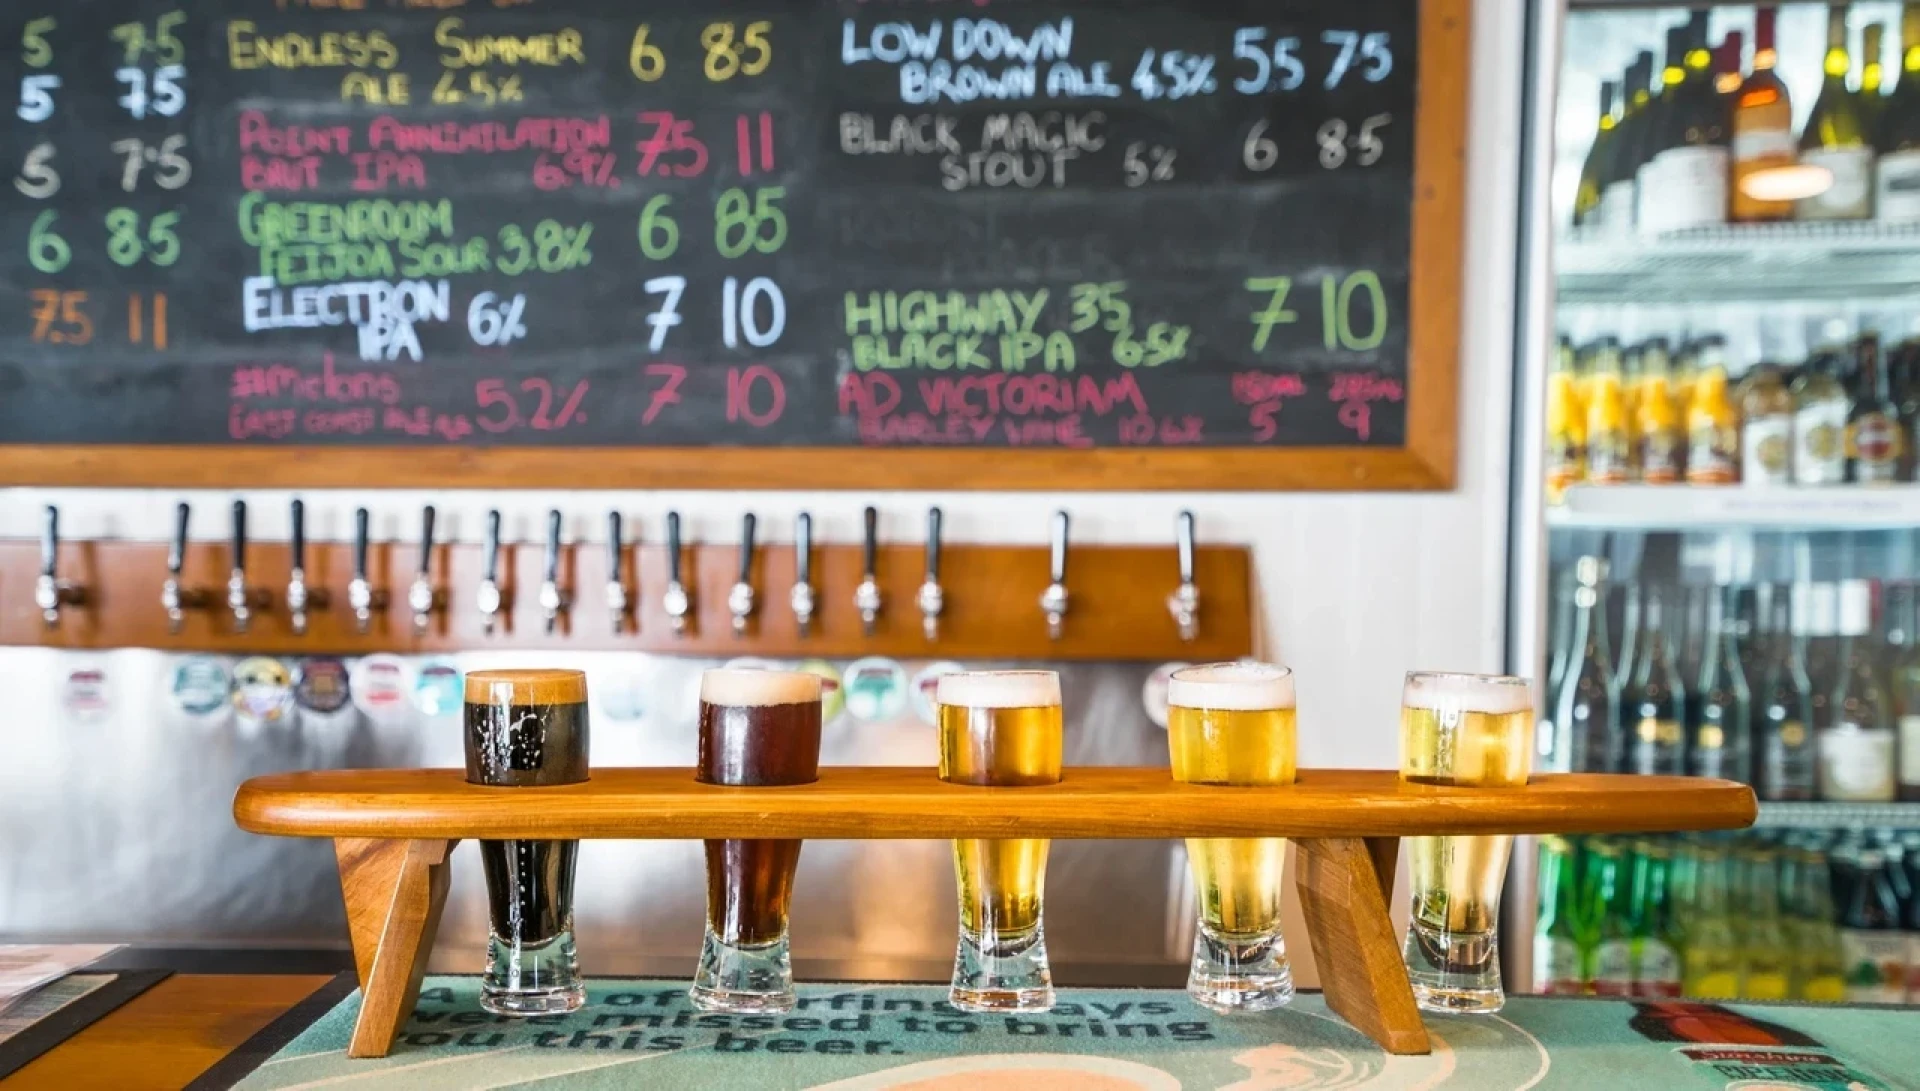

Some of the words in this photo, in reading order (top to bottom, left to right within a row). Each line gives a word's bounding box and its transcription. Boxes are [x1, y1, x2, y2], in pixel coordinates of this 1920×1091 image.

[21, 16, 58, 68] 5
[228, 20, 399, 69] ENDLESS
[434, 17, 585, 68] SUMMER
[630, 23, 666, 82] 6
[701, 20, 772, 82] 8.5
[842, 19, 942, 64] LOW
[953, 16, 1073, 61] DOWN
[16, 74, 62, 122] 5
[341, 72, 409, 105] ALE
[901, 58, 1036, 103] BROWN
[1046, 61, 1122, 99] ALE
[240, 110, 349, 157] POINT
[636, 111, 708, 178] 7.5
[736, 110, 774, 177] 11
[839, 112, 960, 155] BLACK
[981, 111, 1107, 153] MAGIC
[940, 148, 1080, 191] STOUT
[1123, 142, 1177, 188] 5%
[1242, 118, 1278, 171] 6
[13, 142, 61, 199] 5
[241, 156, 322, 190] BRUT
[350, 152, 426, 191] IPA
[533, 151, 621, 191] 6.9%
[28, 208, 72, 273] 6
[239, 190, 453, 246] GREENROOM
[639, 193, 679, 260] 6
[261, 240, 395, 285] FEIJOA
[497, 219, 594, 276] 3.8%
[30, 288, 94, 345] 7.5
[128, 293, 168, 351] 11
[243, 276, 450, 333] ELECTRON
[467, 291, 528, 346] 6%
[644, 275, 687, 353] 7
[722, 276, 786, 348] 10
[844, 288, 1049, 336] HIGHWAY
[1069, 281, 1133, 334] 35
[1244, 275, 1298, 353] 7
[1320, 269, 1388, 352] 10
[358, 318, 424, 362] IPA
[852, 330, 992, 372] BLACK
[999, 330, 1077, 372] IPA
[642, 364, 687, 425] 7
[726, 364, 787, 427] 10
[838, 372, 901, 420] AD
[918, 371, 1149, 418] VICTORIAM
[1249, 399, 1283, 442] 5
[1337, 400, 1371, 441] 9
[592, 1012, 870, 1031] missed
[896, 1016, 978, 1034] to
[1004, 1017, 1215, 1041] bring
[603, 988, 688, 1006] of
[1049, 1001, 1177, 1019] ays
[397, 1029, 506, 1047] ou
[532, 1030, 685, 1050] this
[714, 1031, 905, 1056] beer.
